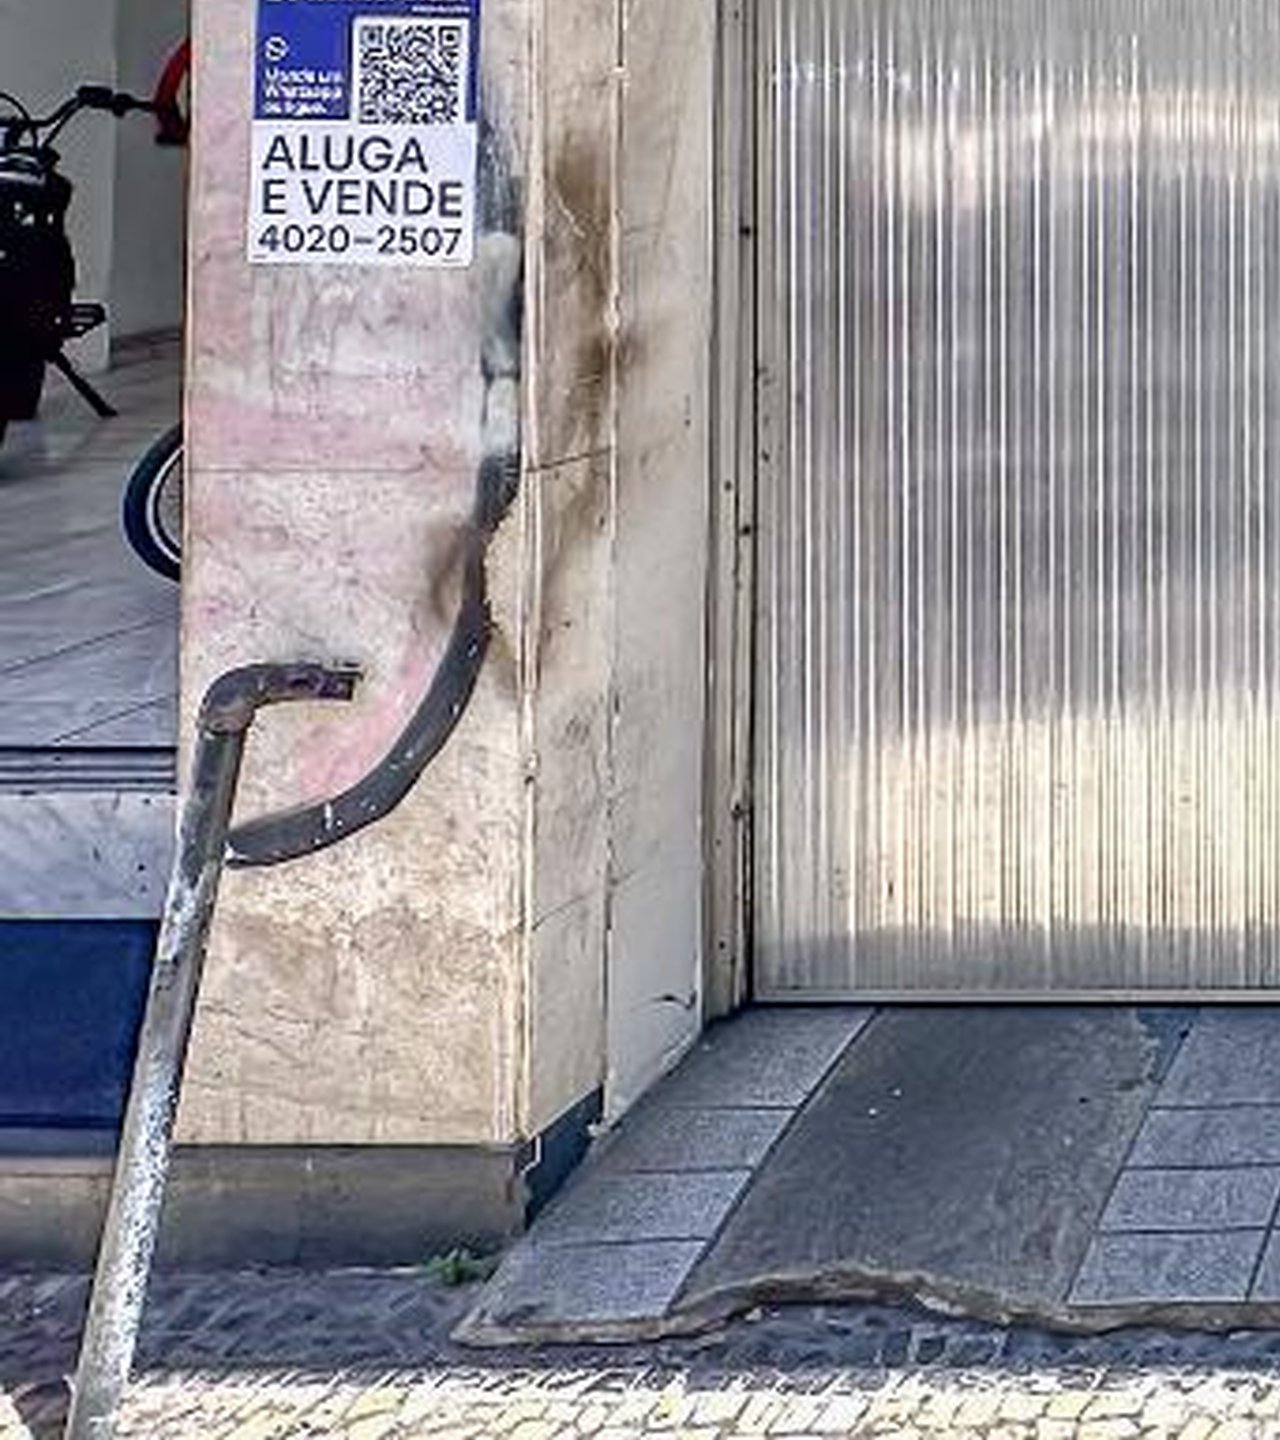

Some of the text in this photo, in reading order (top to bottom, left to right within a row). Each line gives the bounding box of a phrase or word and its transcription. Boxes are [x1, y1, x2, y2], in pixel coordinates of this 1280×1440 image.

[262, 135, 428, 173] ALUGA
[262, 179, 463, 218] E VENDE
[258, 224, 462, 256] 4020-2507
